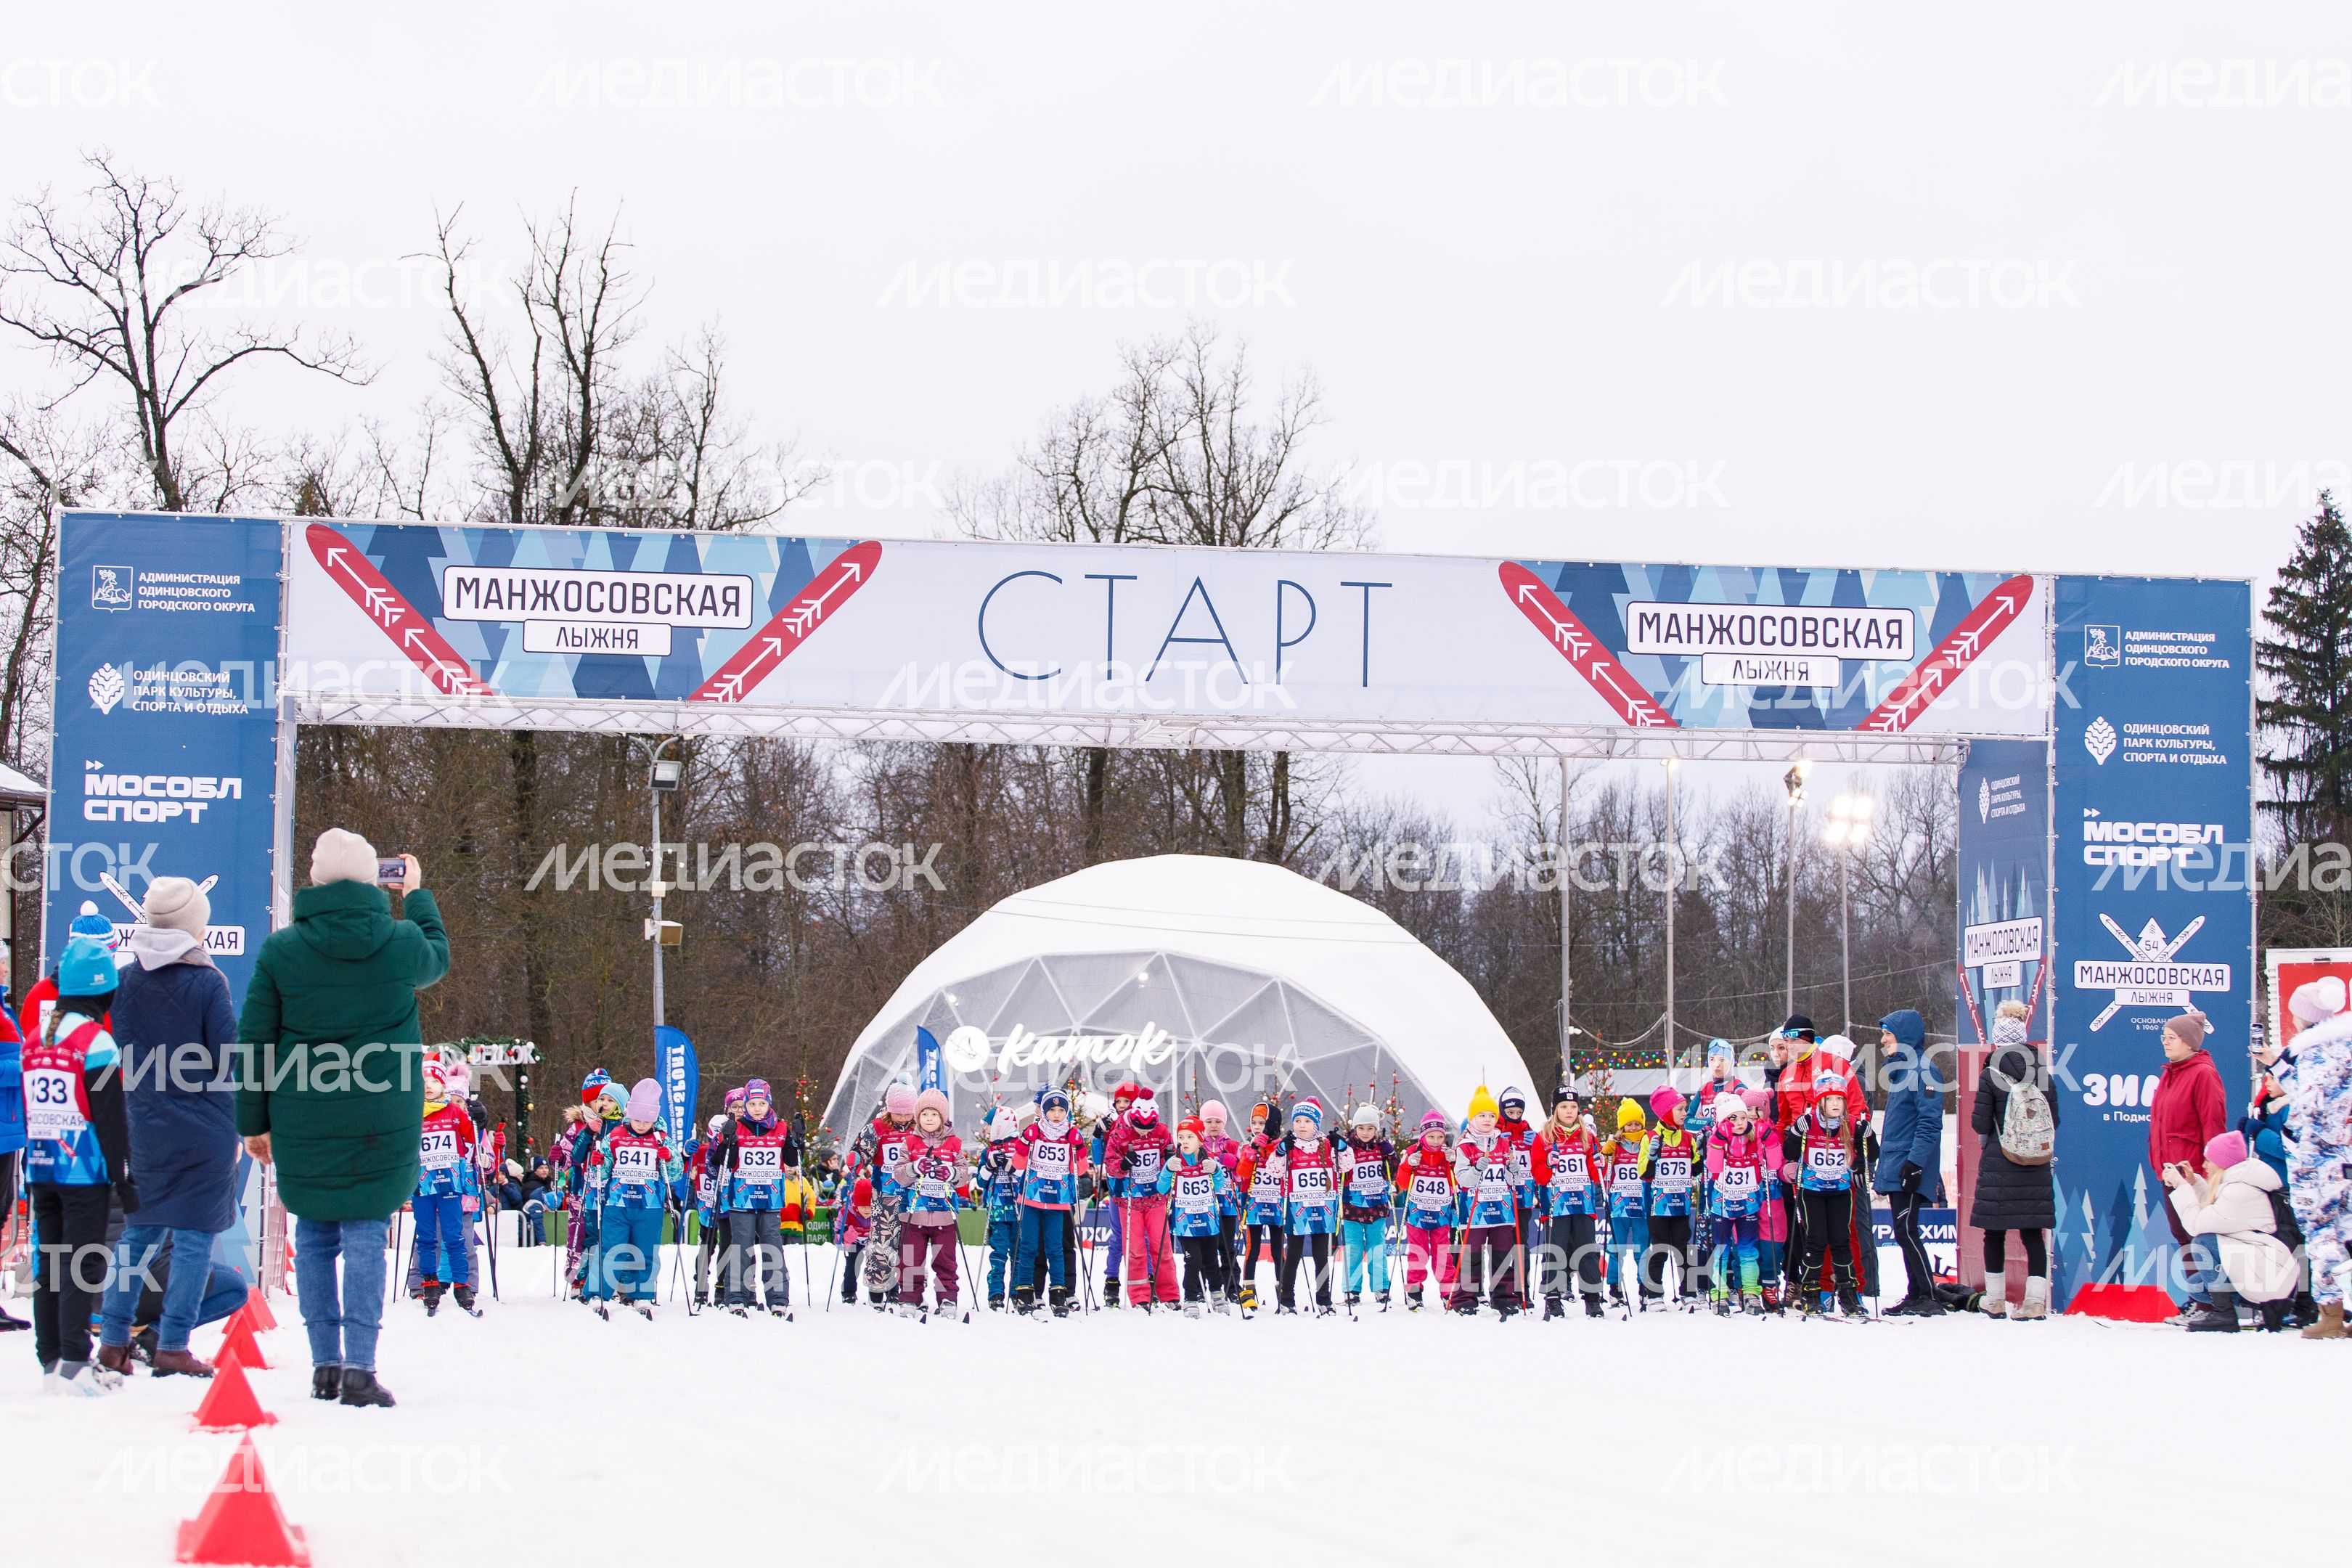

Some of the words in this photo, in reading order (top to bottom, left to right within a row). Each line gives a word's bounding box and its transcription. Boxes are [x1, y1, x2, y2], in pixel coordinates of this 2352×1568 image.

[139, 573, 240, 585] АДМИНИСТРАЦИЯ
[139, 585, 231, 600] ОДИНЦОВСКОГО
[456, 577, 740, 617] МАНЖОСОВСКАЯ
[138, 600, 210, 611] ГОРОДСКОГО
[213, 601, 256, 613] ОКРУГА
[979, 571, 1392, 687] СТАРТ
[1638, 611, 1903, 650] МАНЖОСОВСКАЯ
[556, 626, 639, 650] ЛЫЖНЯ
[2126, 631, 2216, 644] АДМИНИСТРАЦИЯ
[2126, 644, 2208, 656] ОДИНЦОВСКОГО
[1732, 658, 1810, 681] ЛЫЖНЯ
[2125, 657, 2190, 667] ГОРОДСКОГО
[2192, 658, 2229, 669] ОКРУГА
[134, 669, 231, 684] ОДИНЦОВСКИЙ
[133, 685, 166, 698] ПАРК
[169, 686, 237, 701] КУЛЬТУРЫ,
[132, 700, 181, 712] СПОРТА
[184, 702, 193, 712] И
[196, 703, 248, 716] ОТДЫХА
[2123, 722, 2210, 735] ОДИНЦОВСКИЙ
[2123, 738, 2153, 748] ПАРК
[2156, 738, 2216, 751] КУЛЬТУРЫ,
[2123, 752, 2166, 763] СПОРТА
[2170, 754, 2177, 763] И
[2181, 754, 2227, 766] ОТДЫХА
[84, 775, 242, 799] МОСОБЛ
[84, 799, 208, 824] СПОРТ
[2083, 822, 2224, 845] МОСОБЛ
[2083, 846, 2194, 867] СПОРТ
[1967, 926, 2038, 958] МАНЖОСОВСКАЯ
[2145, 940, 2159, 952] 54
[1991, 966, 2012, 984] ЛЫЖНЯ
[2080, 965, 2224, 987] МАНЖОСОВСКАЯ
[2131, 991, 2173, 1004] ЛЫЖНЯ
[32, 1077, 67, 1103] 33
[2083, 1074, 2160, 1107] ЗИ
[2114, 1111, 2151, 1122] Подмо
[422, 1135, 452, 1151] 674
[620, 1151, 649, 1166] 641
[744, 1151, 775, 1165] 632
[1038, 1145, 1066, 1161] 653
[1815, 1152, 1845, 1166] 662
[1558, 1158, 1583, 1173] 661
[1661, 1161, 1686, 1175] 676
[1299, 1172, 1326, 1188] 656
[1481, 1168, 1504, 1182] 44
[1619, 1167, 1638, 1180] 66
[1726, 1171, 1749, 1185] 631
[1183, 1180, 1209, 1195] 663
[1416, 1180, 1445, 1195] 648
